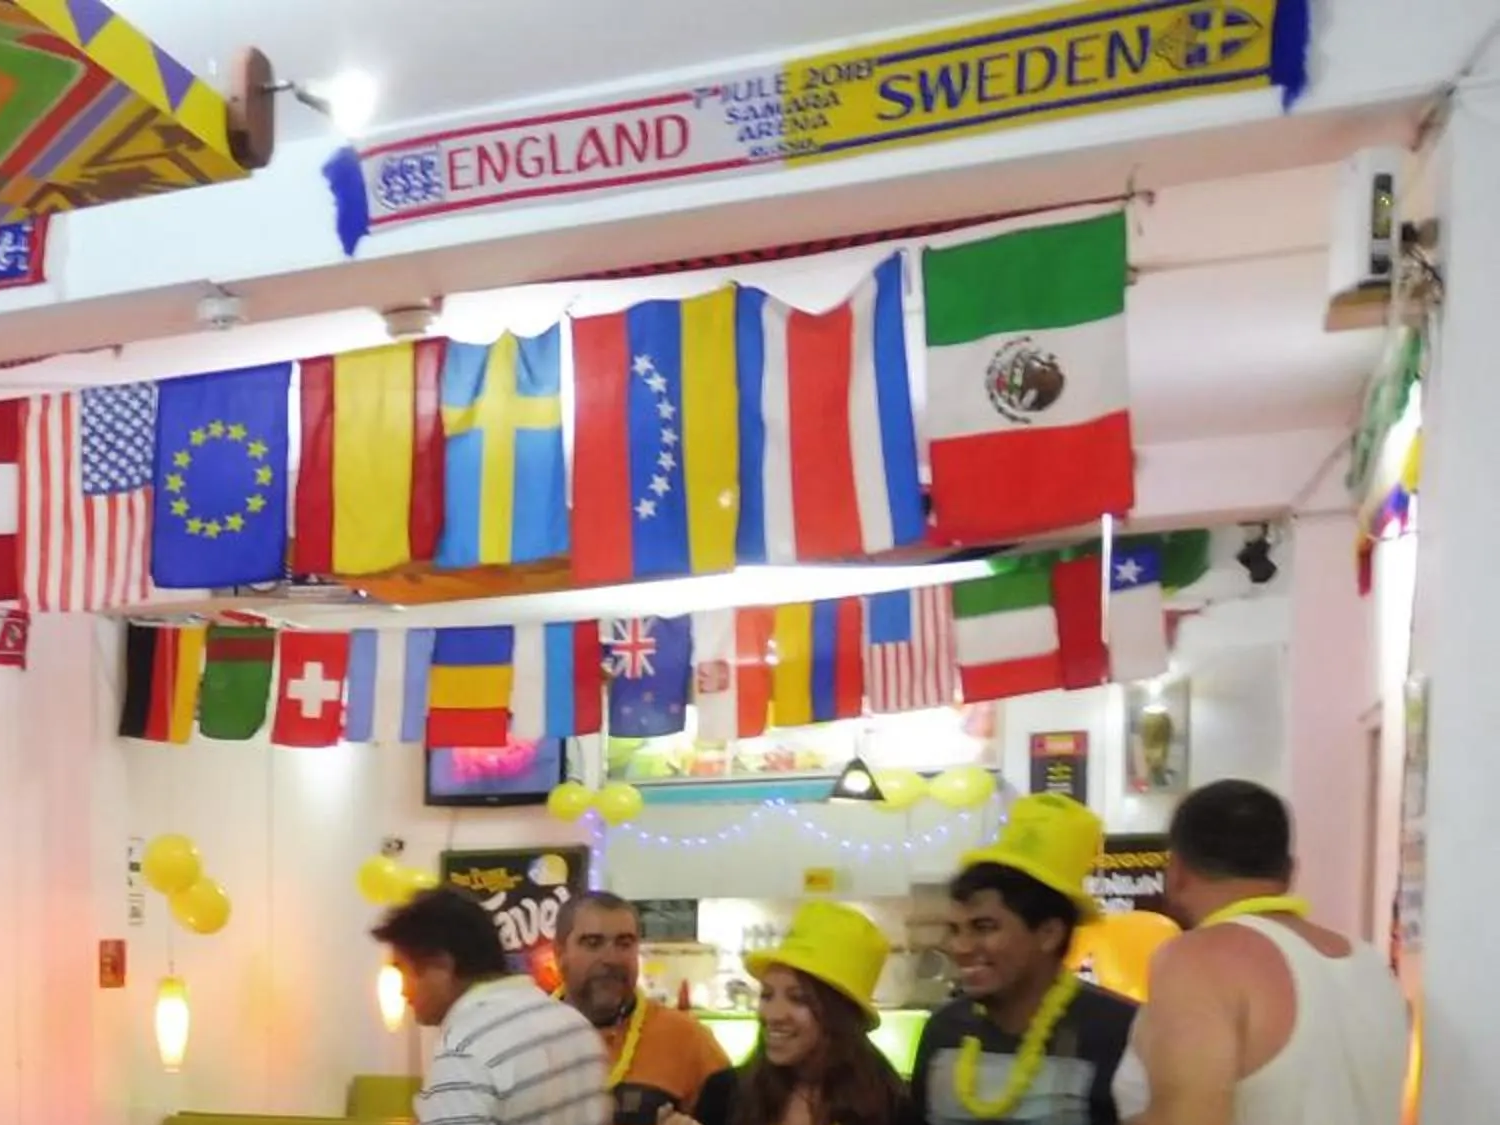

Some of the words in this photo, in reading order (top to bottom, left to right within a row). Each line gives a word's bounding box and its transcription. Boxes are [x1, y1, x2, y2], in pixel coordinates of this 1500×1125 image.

[875, 25, 1151, 121] SWEDEN
[725, 90, 841, 125] SAMARA
[737, 112, 830, 142] ARENA
[448, 113, 690, 192] ENGLAND
